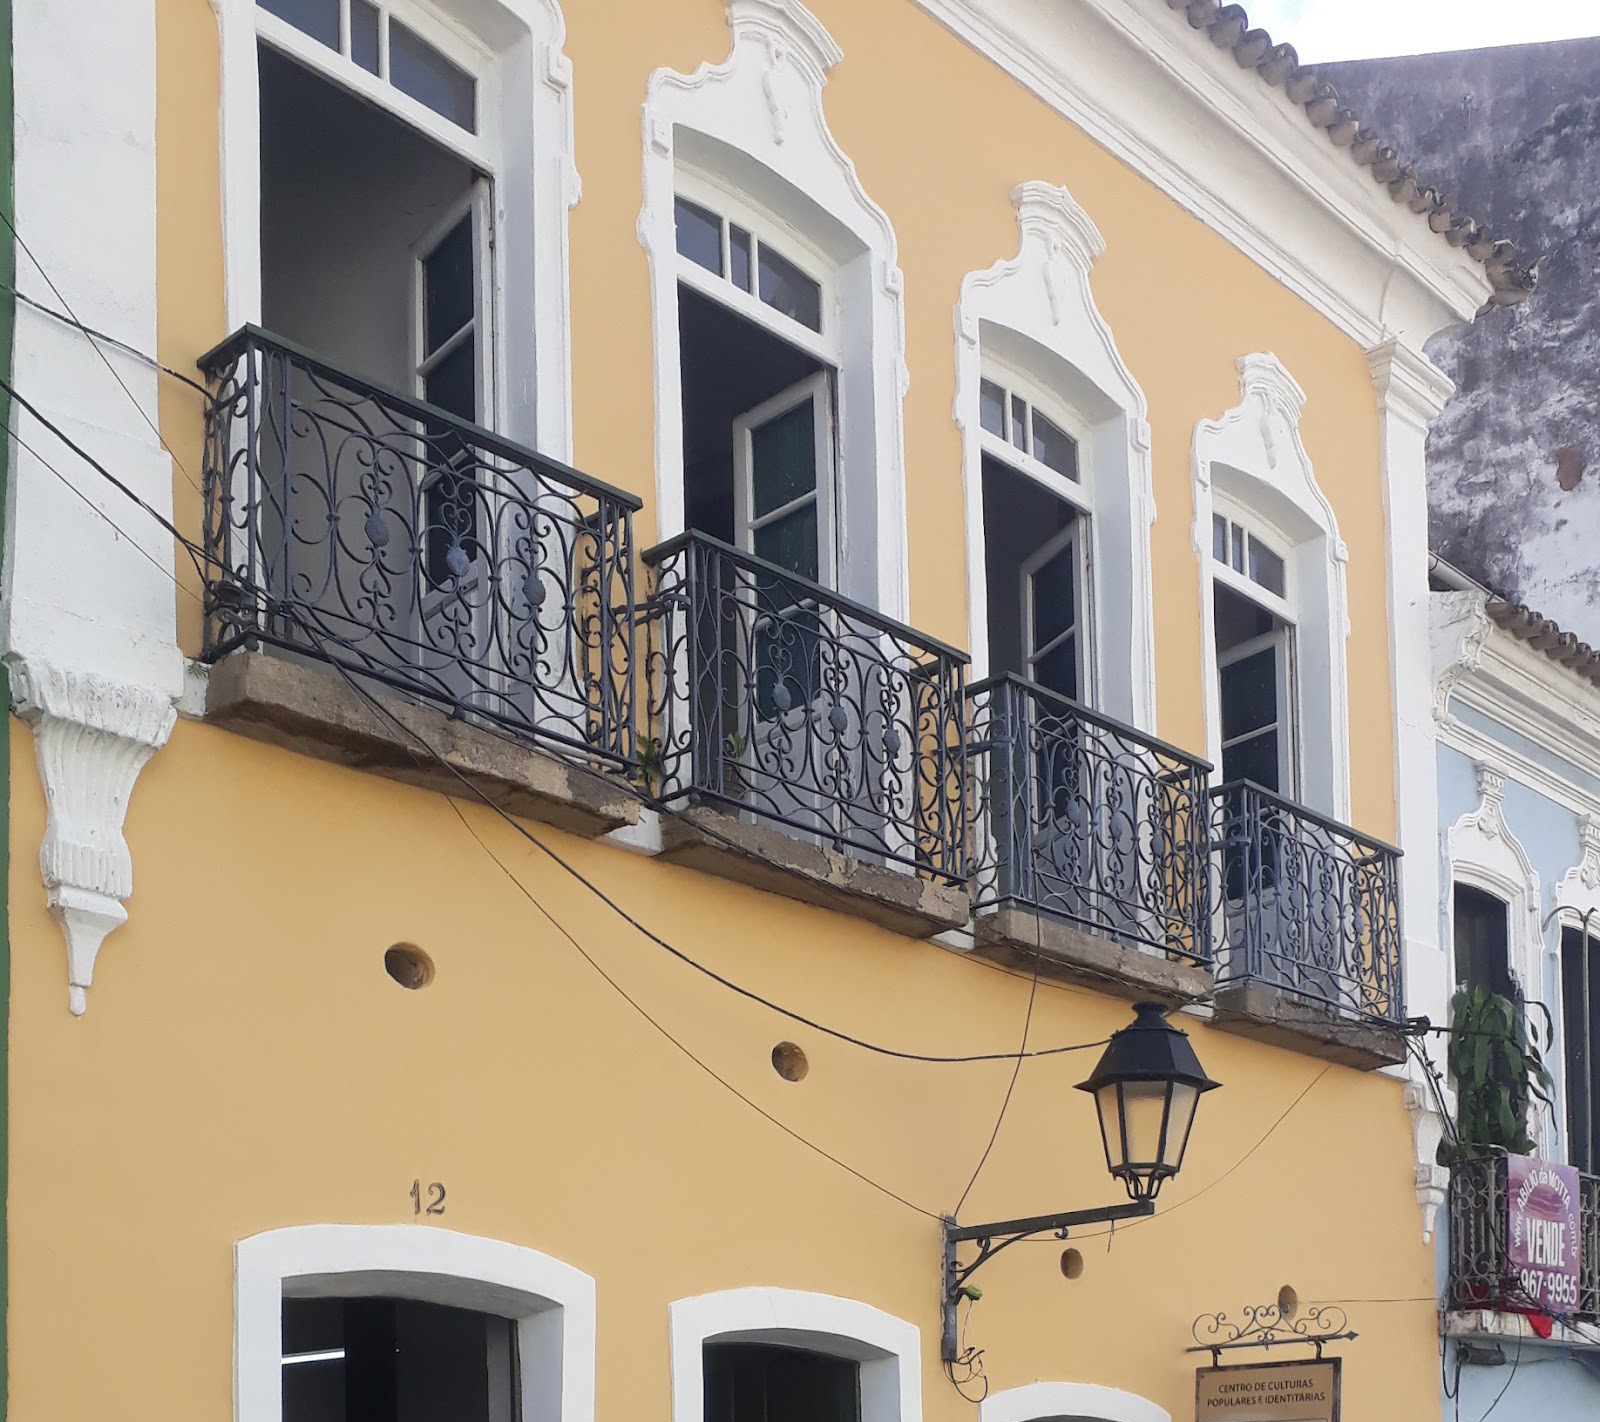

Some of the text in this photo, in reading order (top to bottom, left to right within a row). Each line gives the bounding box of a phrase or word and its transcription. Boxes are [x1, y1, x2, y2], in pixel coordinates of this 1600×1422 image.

[409, 1178, 446, 1216] 12
[1526, 1217, 1566, 1268] VENDE
[1207, 1391, 1326, 1408] POPULARES E IDENTITÁRIAS
[1218, 1378, 1314, 1394] CENTRO DE CULTURAS
